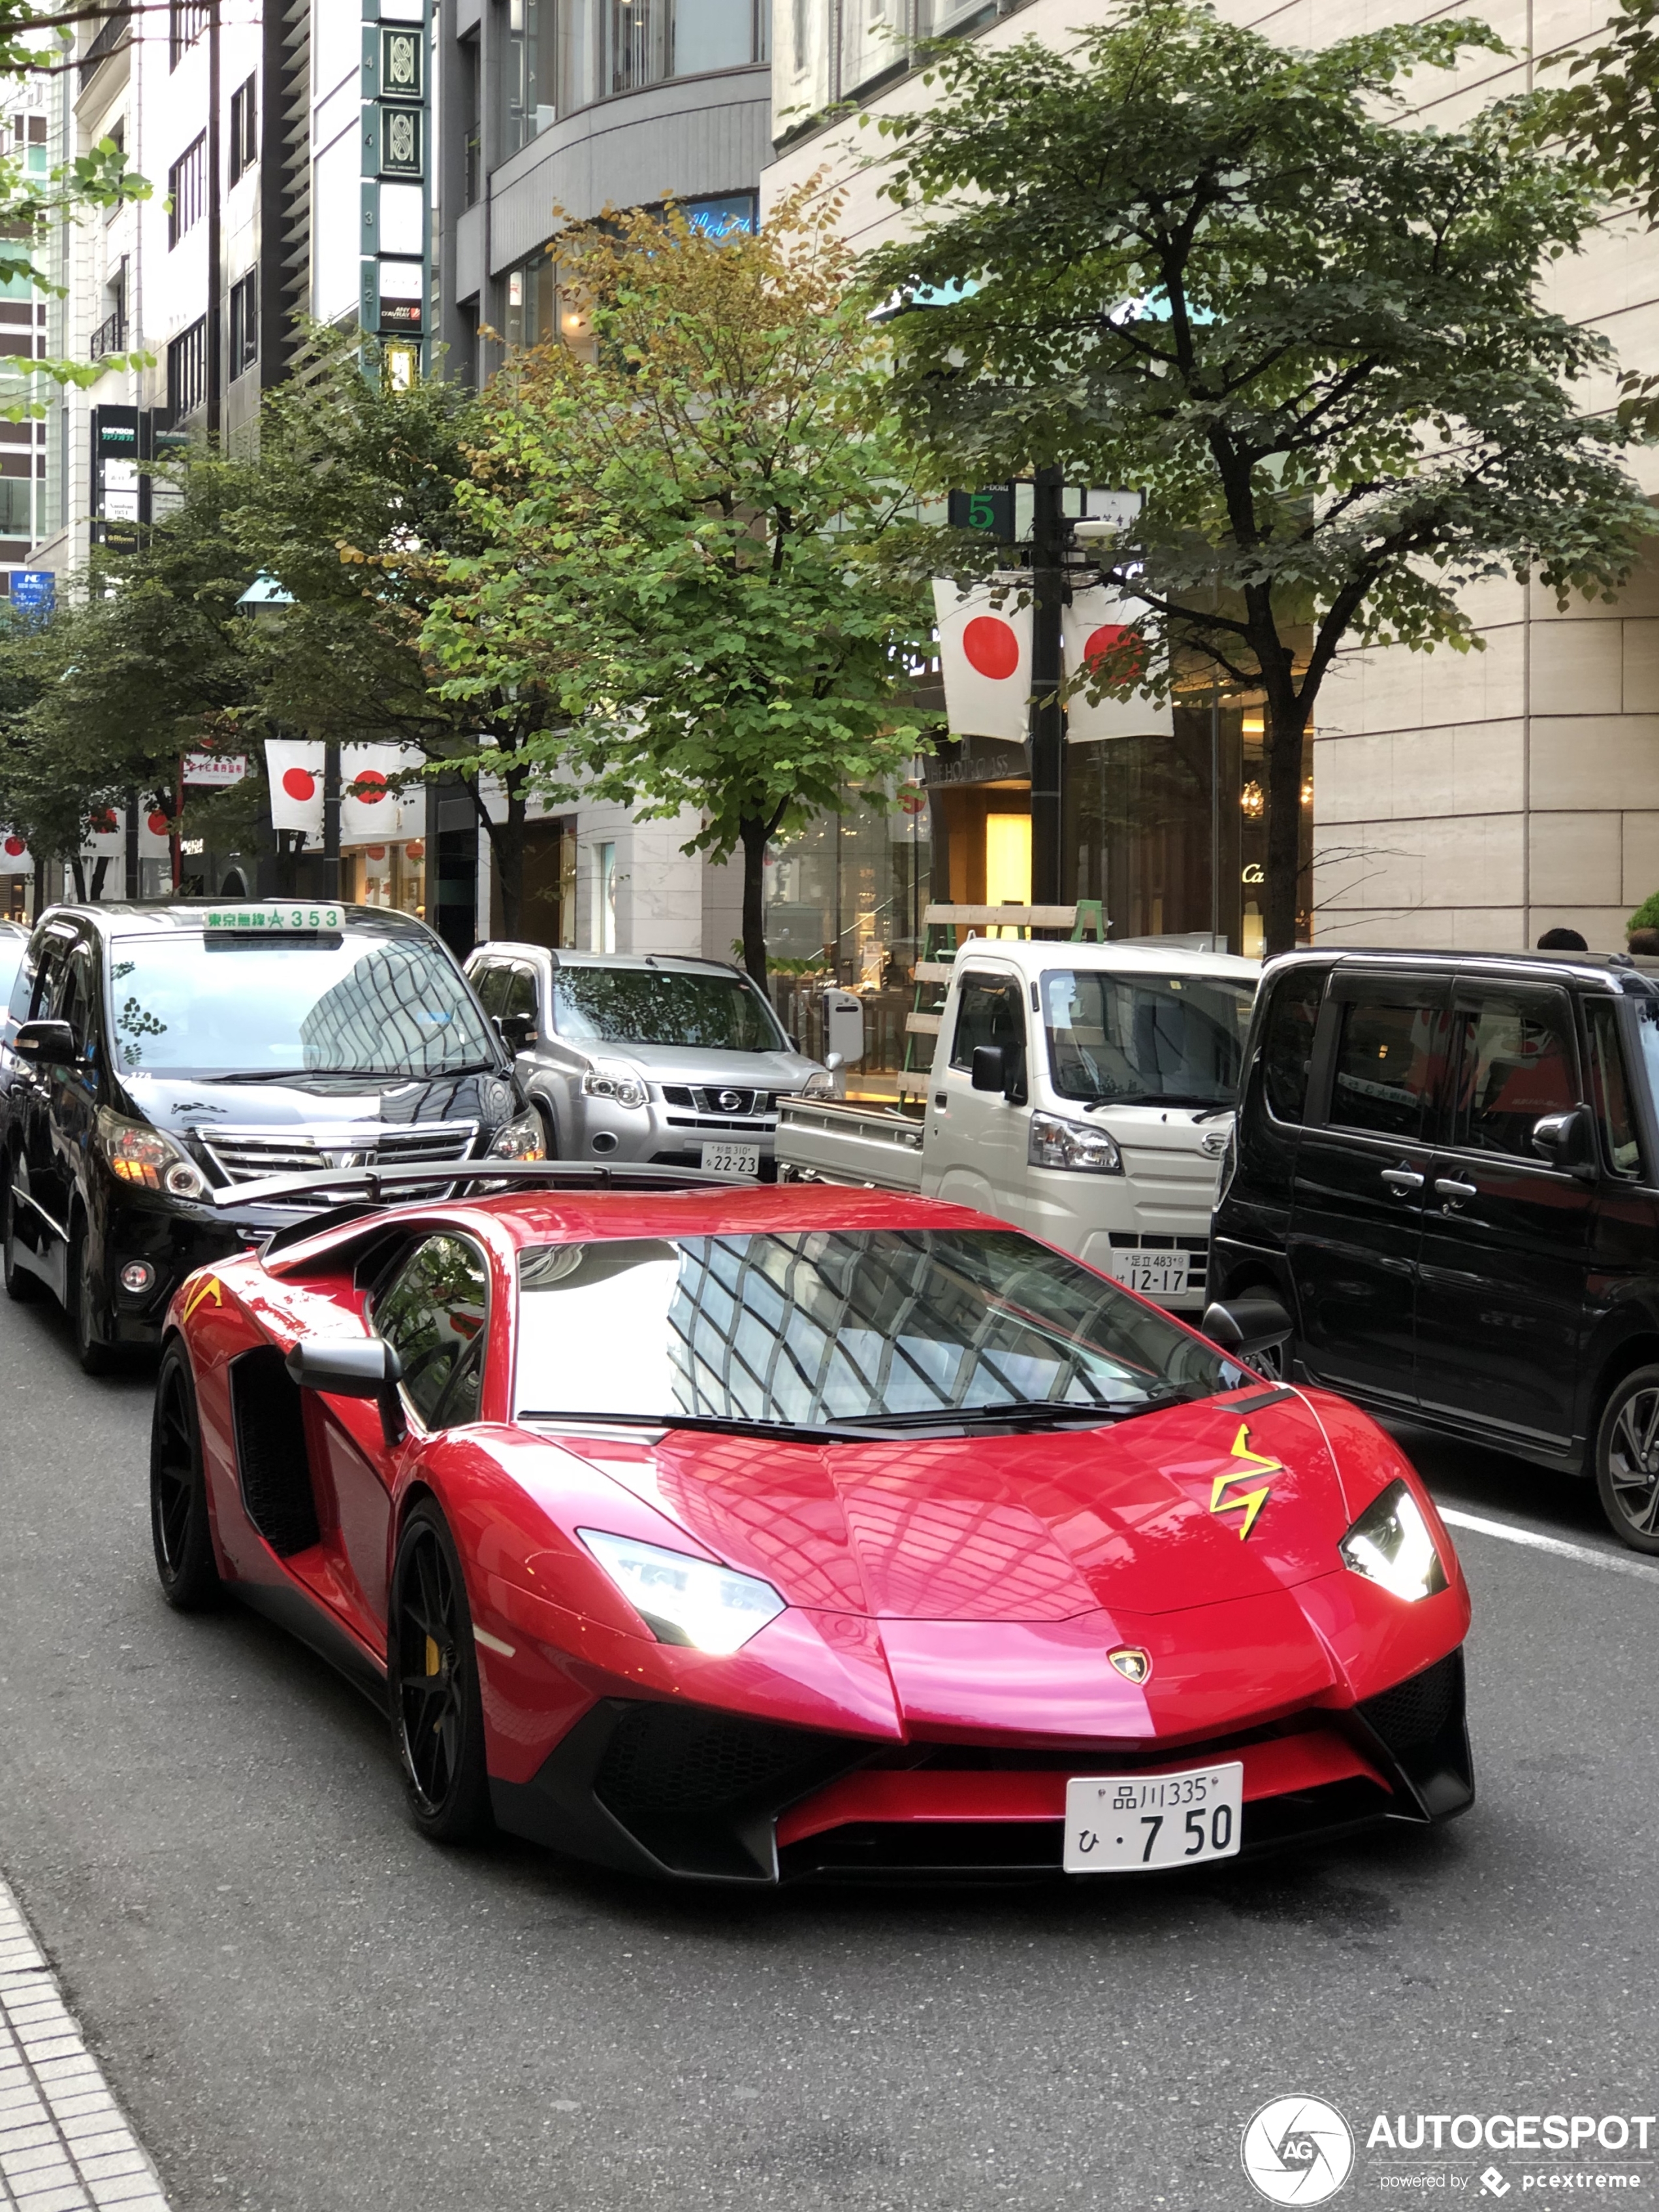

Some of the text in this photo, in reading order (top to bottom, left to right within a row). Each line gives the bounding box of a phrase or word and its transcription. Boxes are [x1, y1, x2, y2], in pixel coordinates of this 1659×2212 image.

[365, 56, 373, 69] 4
[365, 212, 373, 225] 3
[969, 494, 995, 528] 5
[208, 912, 266, 927] 東京無線
[714, 1155, 756, 1172] 22-23
[1131, 1269, 1184, 1291] 12-17
